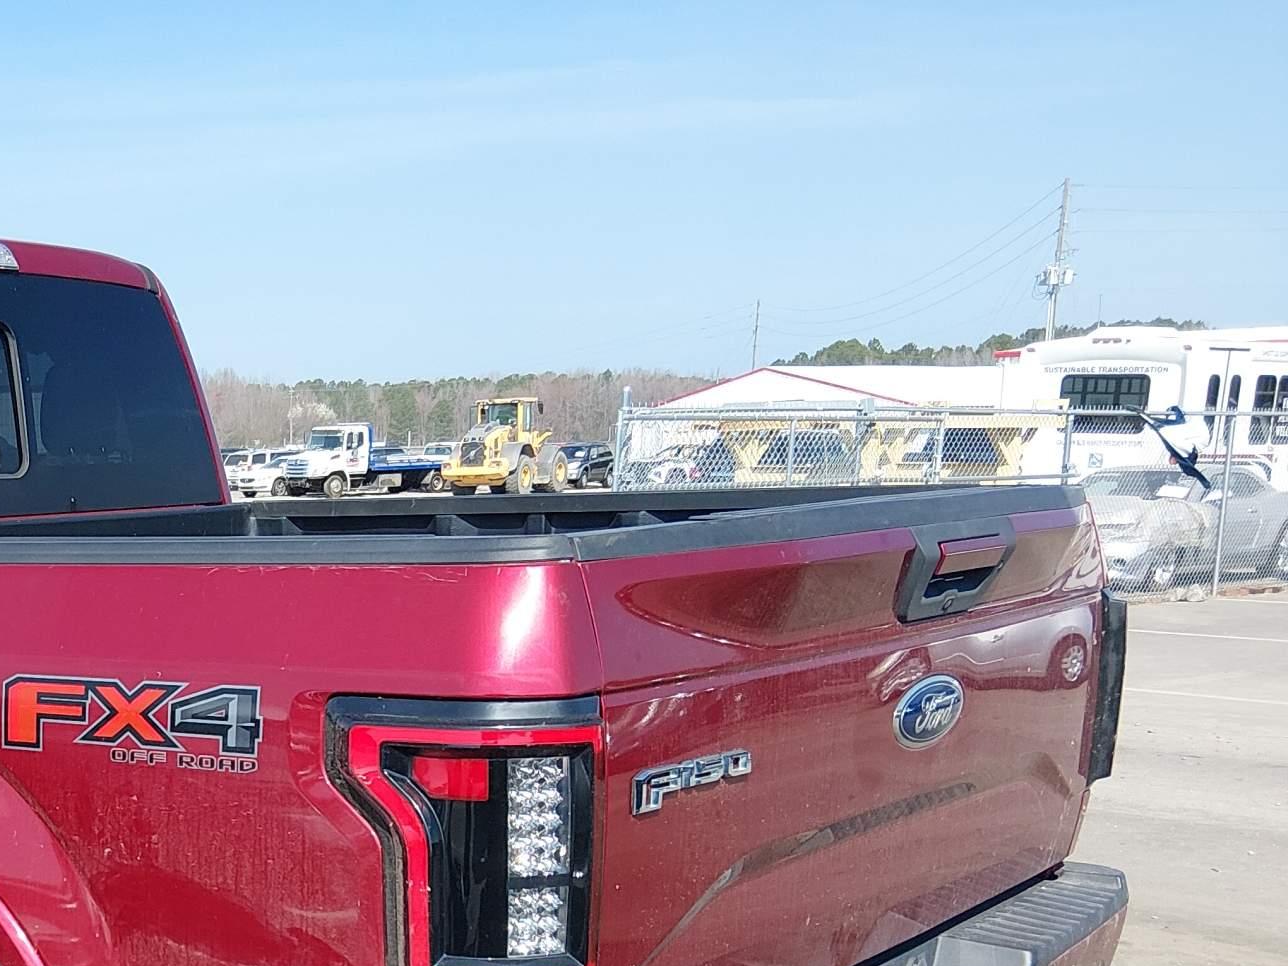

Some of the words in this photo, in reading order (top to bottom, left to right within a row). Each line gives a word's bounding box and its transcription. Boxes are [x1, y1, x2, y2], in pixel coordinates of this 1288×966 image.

[2, 674, 263, 757] FX4
[110, 748, 167, 766] OFF
[176, 754, 258, 773] ROAD
